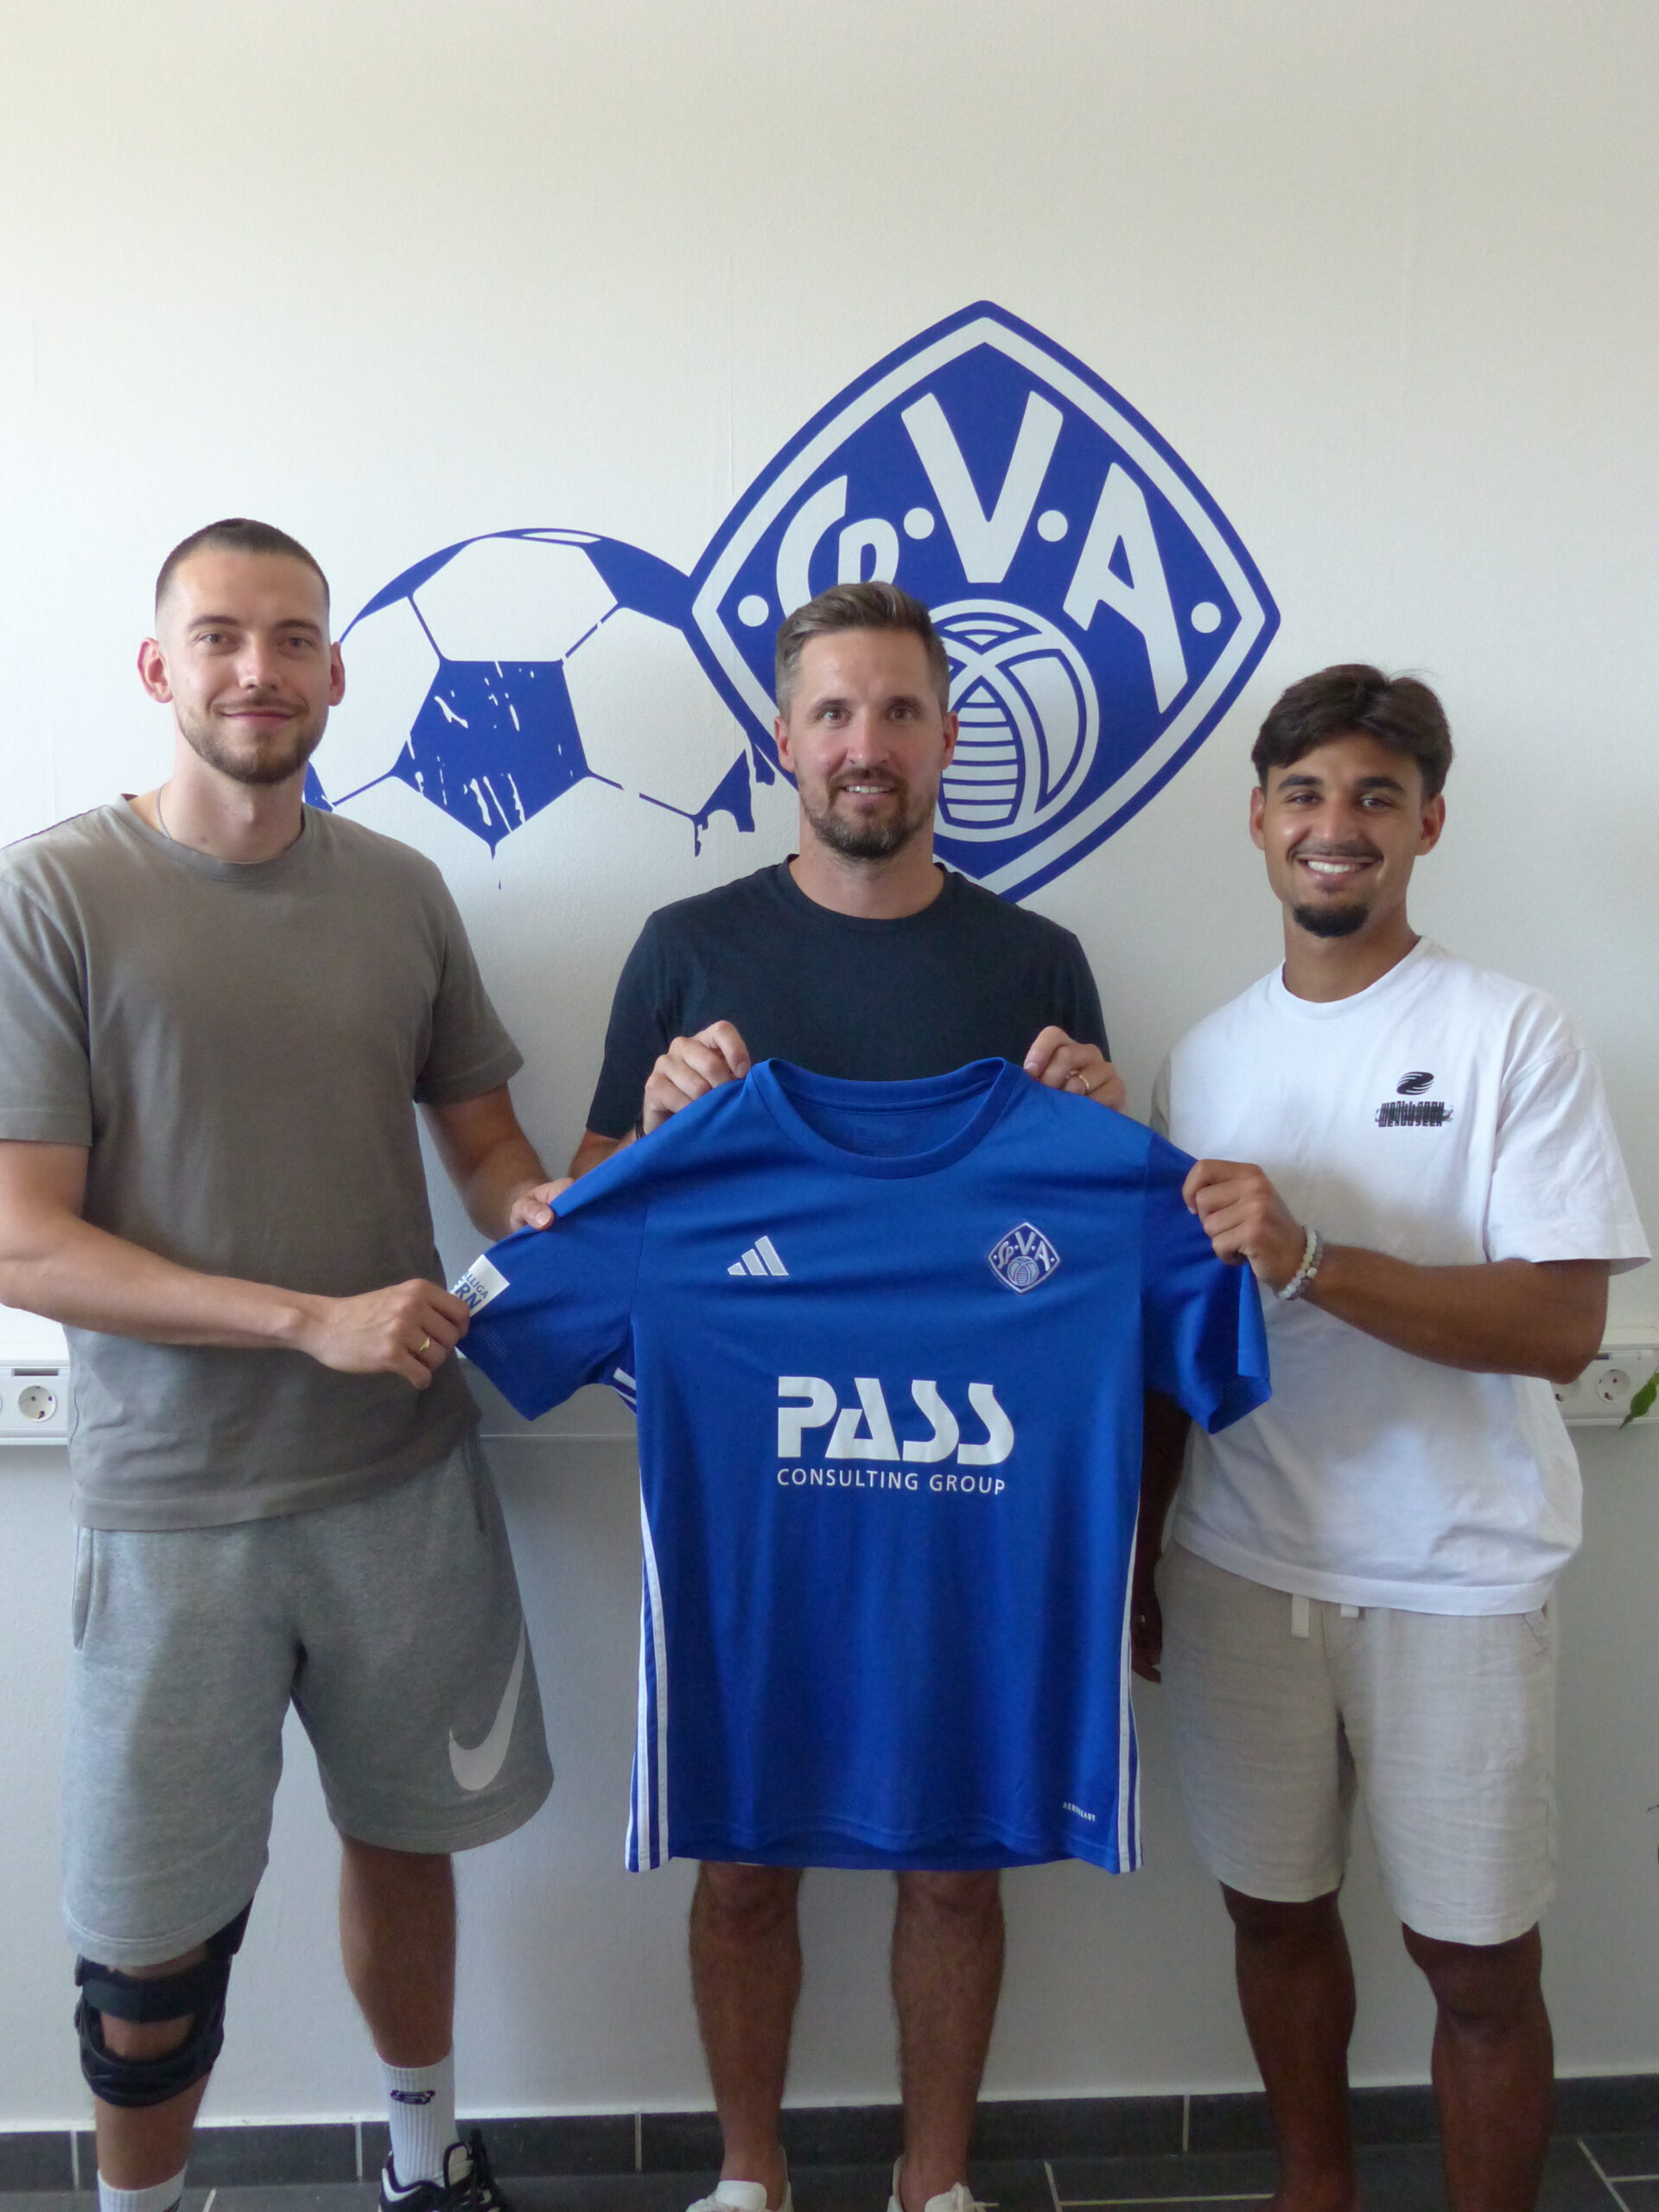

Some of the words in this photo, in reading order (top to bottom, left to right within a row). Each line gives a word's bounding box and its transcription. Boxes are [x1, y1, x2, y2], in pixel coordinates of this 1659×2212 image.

[778, 1376, 1014, 1465] PASS
[778, 1468, 918, 1491] CONSULTING
[929, 1473, 1006, 1495] GROUP
